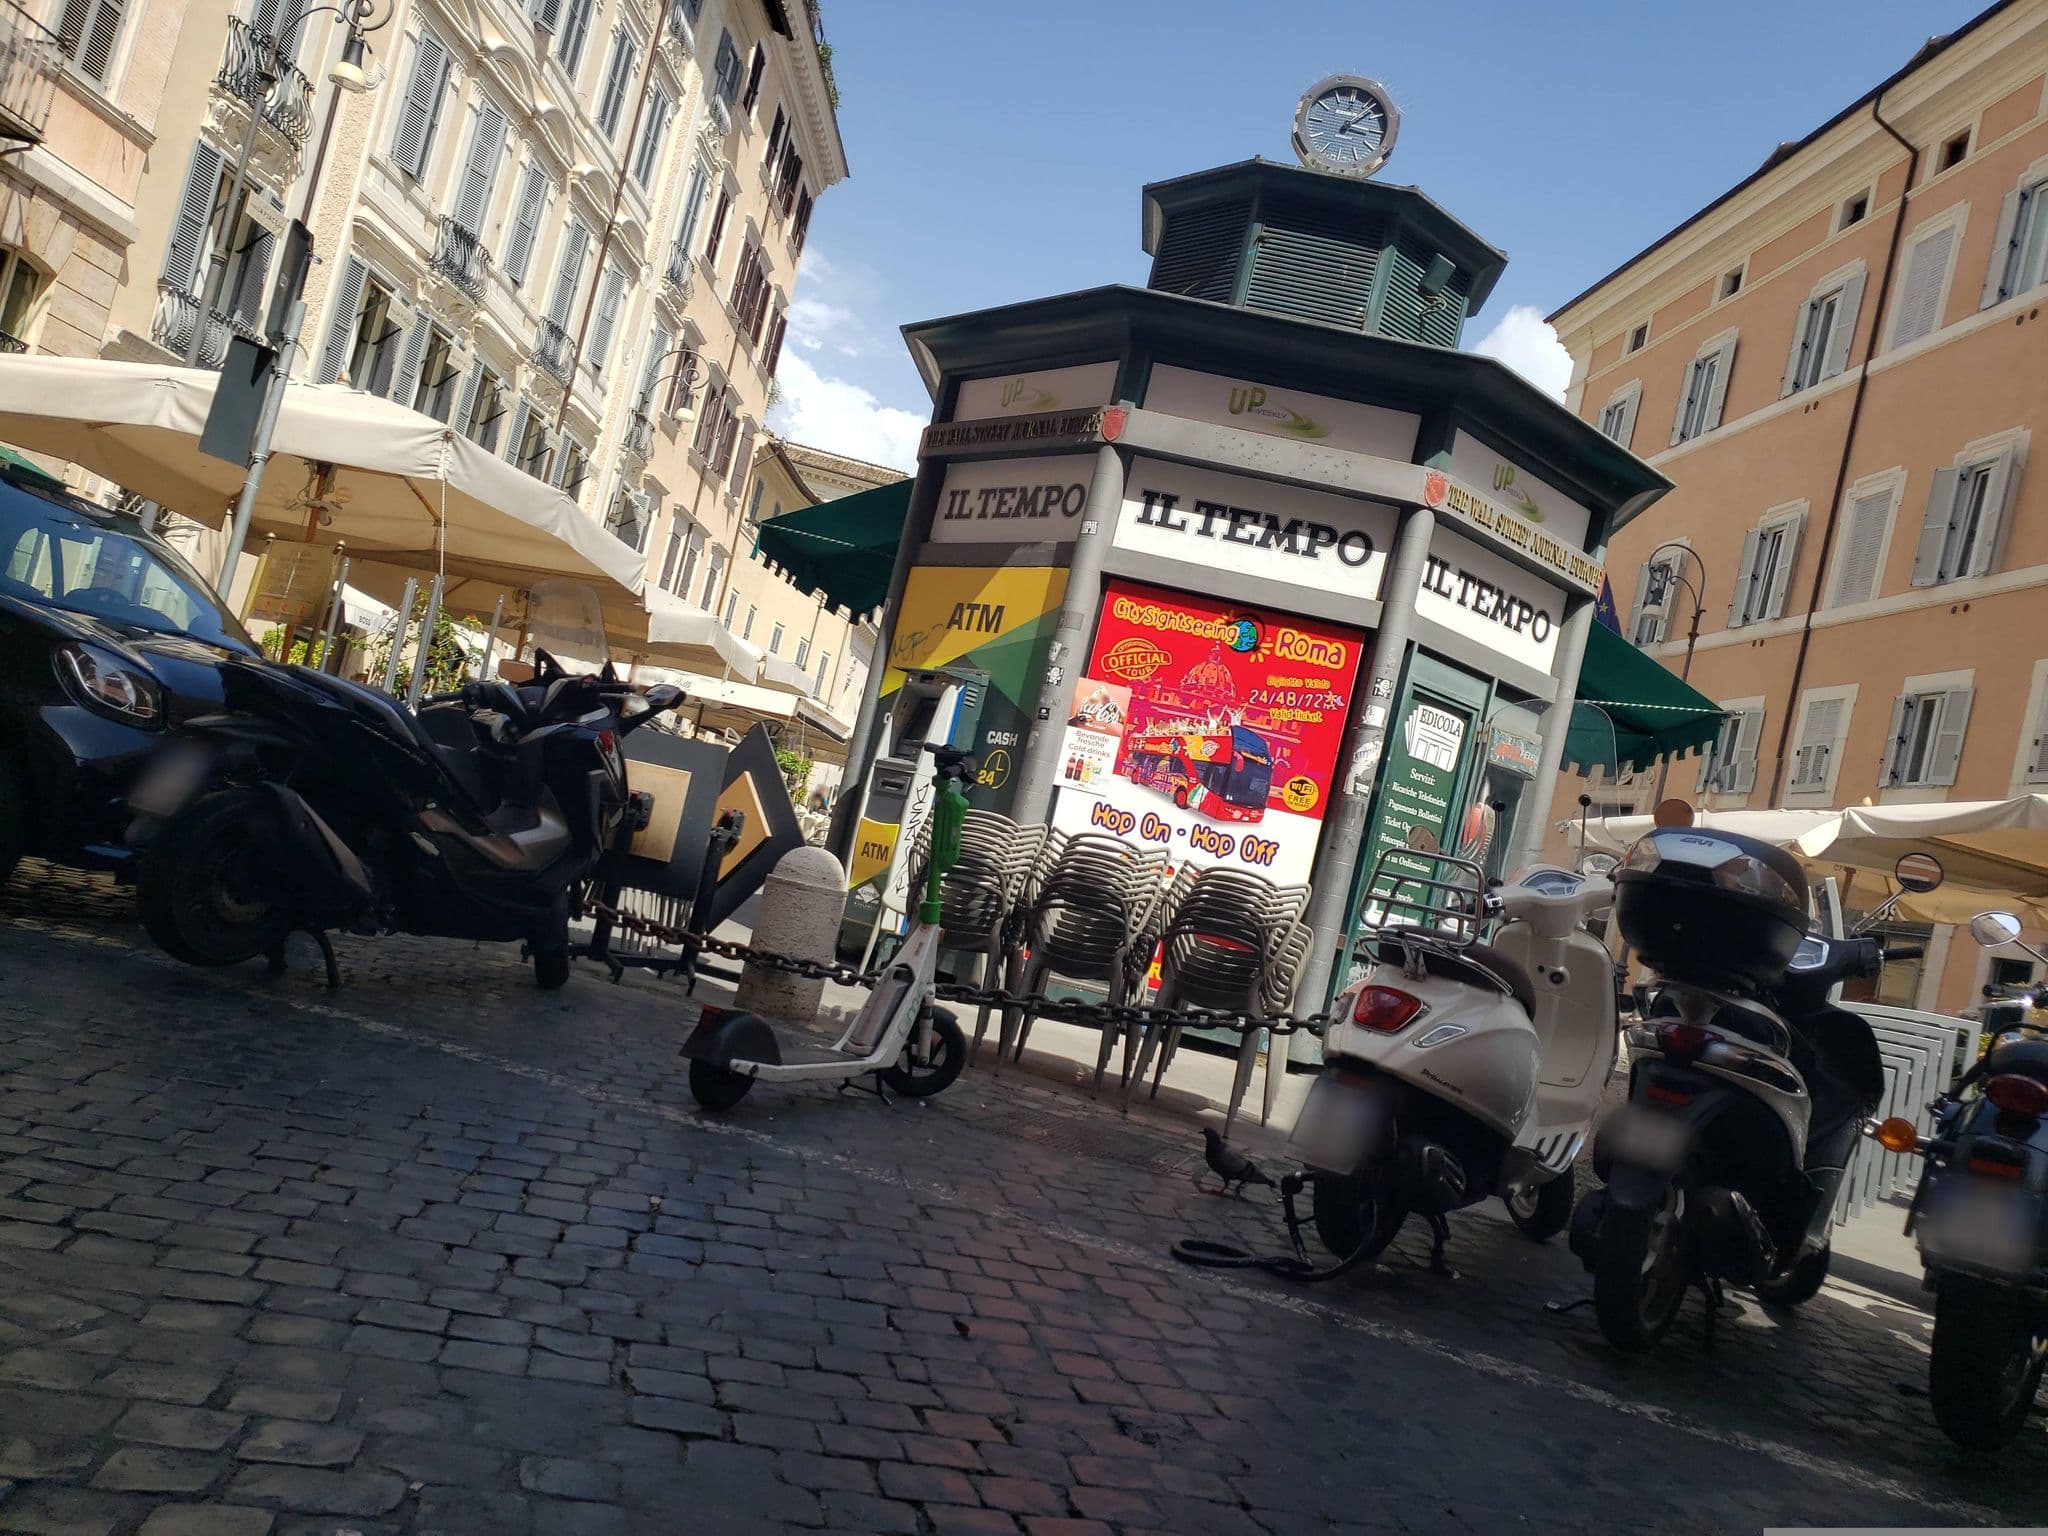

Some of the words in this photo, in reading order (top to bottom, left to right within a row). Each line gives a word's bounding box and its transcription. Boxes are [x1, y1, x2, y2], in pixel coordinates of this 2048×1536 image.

[1001, 378, 1025, 408] UP
[1228, 385, 1267, 415] UP
[927, 429, 945, 448] THE
[1493, 464, 1515, 491] UP
[944, 488, 974, 520] IL
[977, 483, 1086, 520] TEMPO
[1136, 488, 1190, 532] IL
[1194, 499, 1375, 567] TEMPO
[1447, 485, 1469, 514] THE
[1469, 497, 1494, 529] WALL
[1495, 513, 1532, 549] STREET
[1530, 533, 1569, 571] JOURNAL
[1569, 554, 1602, 588] EUROPE
[1422, 552, 1452, 599] IL
[1457, 568, 1551, 643] TEMPO
[946, 602, 1006, 634] ATM
[1113, 597, 1240, 645] CitySightseeing
[1275, 628, 1347, 669] Roma
[1108, 652, 1167, 669] OFFICIAL
[1126, 666, 1153, 678] TOUR
[1270, 708, 1293, 721] Valid
[1294, 709, 1323, 722] Ticket
[1420, 708, 1461, 737] EDICOLA
[986, 730, 1019, 747] CASH
[1076, 730, 1109, 743] Bevande
[1078, 737, 1105, 749] fresche
[1068, 743, 1087, 752] Cold
[1087, 748, 1110, 758] drinks
[977, 769, 996, 785] 24
[1288, 794, 1312, 805] FREE
[1091, 801, 1137, 837] Hop
[1140, 812, 1172, 844] On
[1190, 823, 1236, 859] Hop
[1240, 834, 1281, 867] Off
[861, 841, 890, 862] ATM
